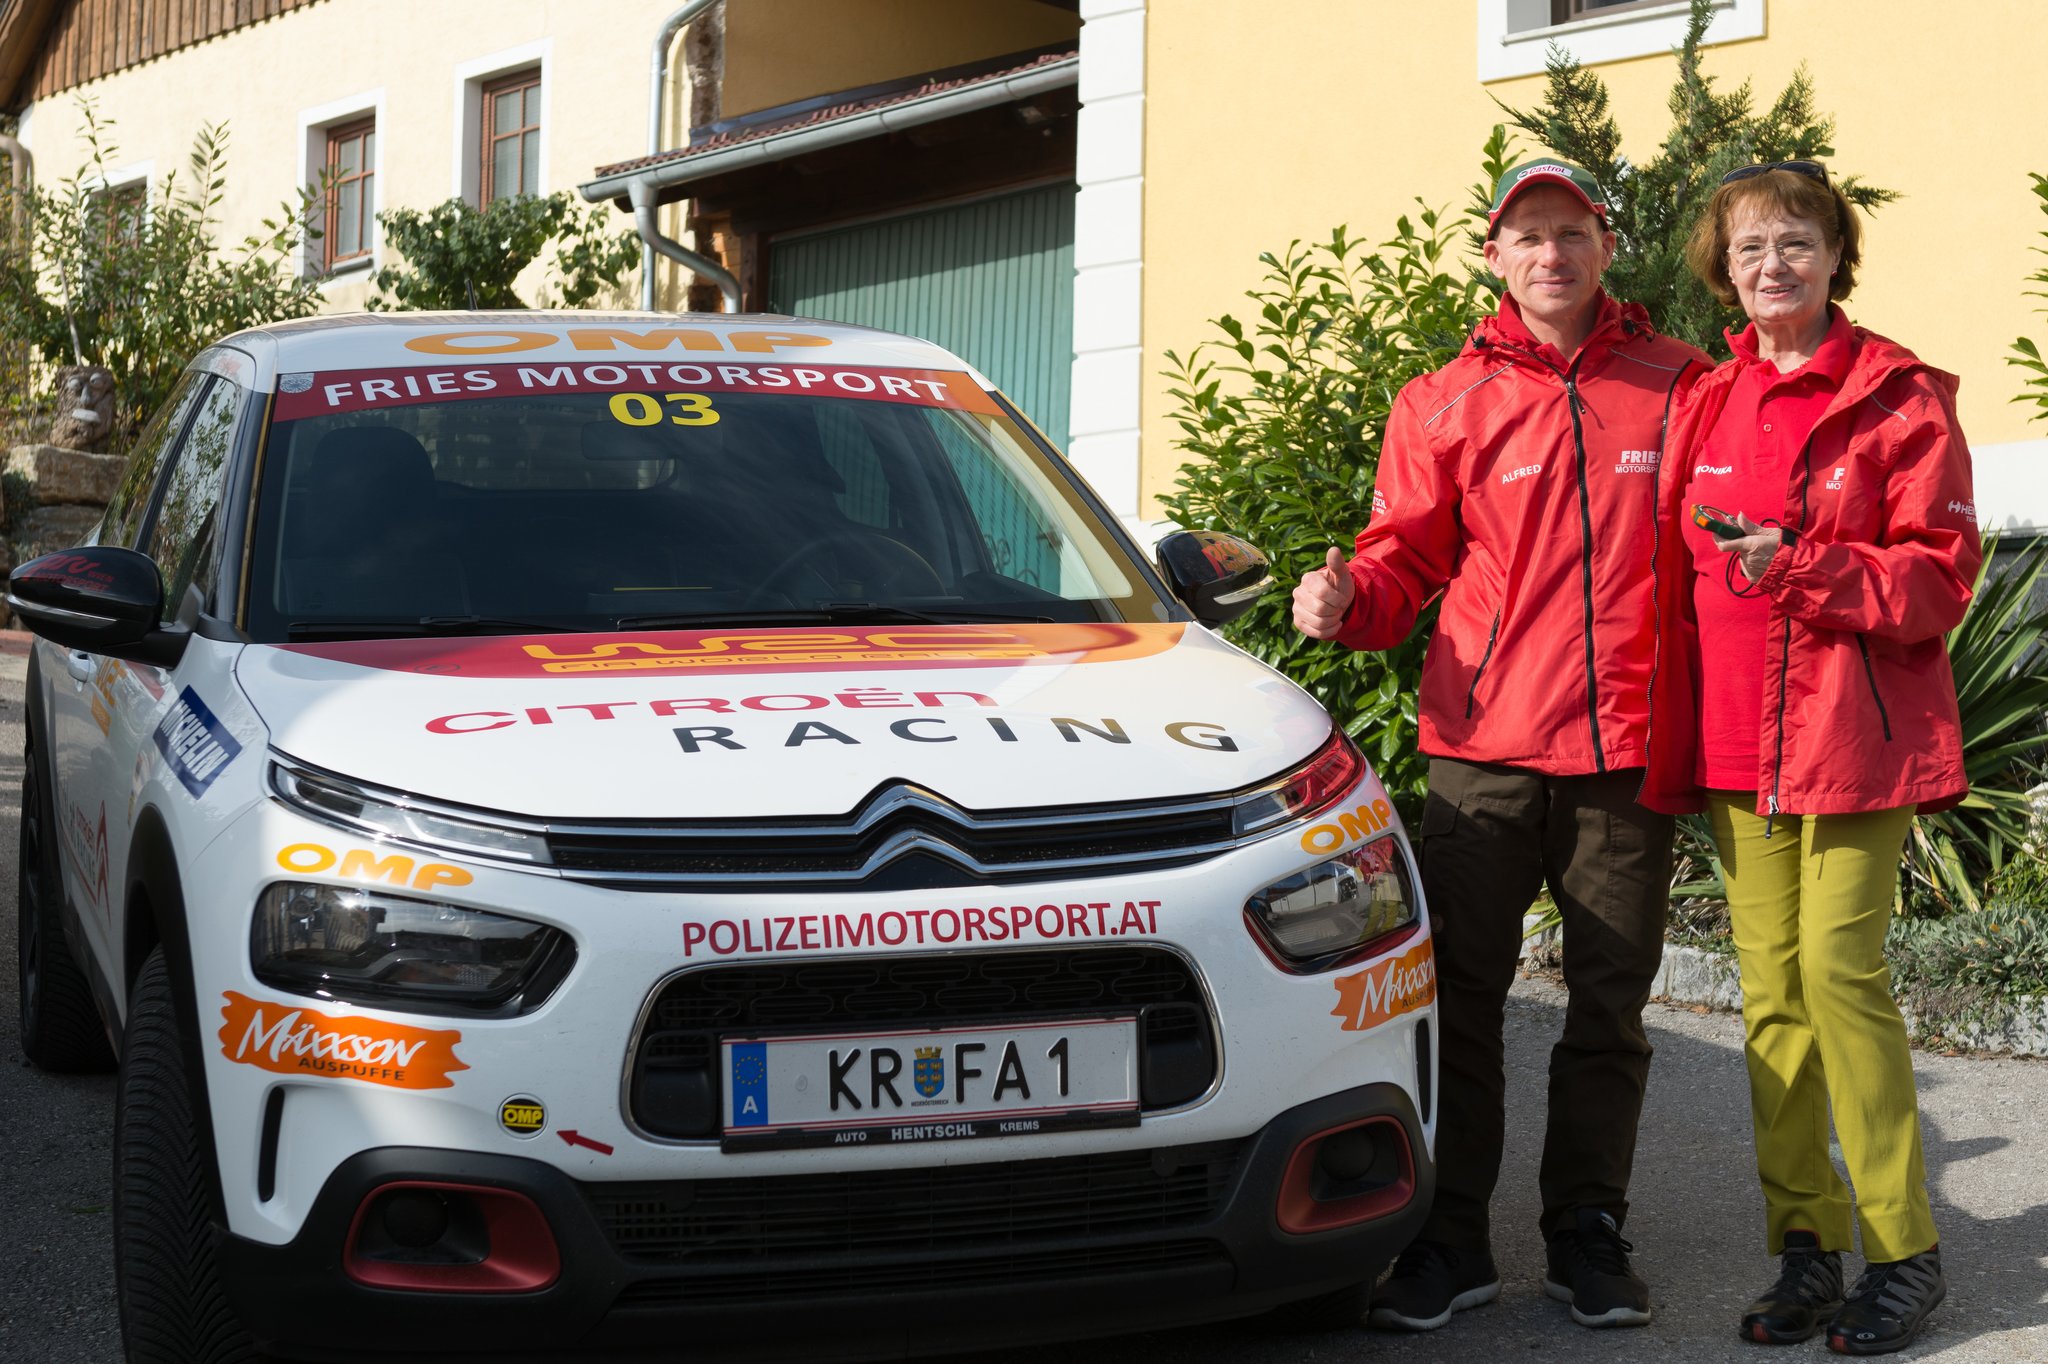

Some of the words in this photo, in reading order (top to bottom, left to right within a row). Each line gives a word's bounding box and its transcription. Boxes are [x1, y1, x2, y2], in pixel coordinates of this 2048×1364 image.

[1529, 165, 1565, 175] Castrol
[403, 328, 834, 356] OMP
[323, 370, 491, 407] FRIES
[519, 364, 947, 401] MOTORSPORT
[608, 392, 720, 427] 03
[1502, 464, 1542, 485] ALFRED
[1615, 465, 1658, 474] MOTORSP
[522, 634, 1035, 659] WRC
[560, 661, 636, 670] FIA
[655, 653, 843, 665] WORLD
[425, 687, 999, 734] CITROËN
[160, 699, 230, 782] MICHELIN
[672, 716, 1239, 753] RACING
[1299, 799, 1391, 855] OMP
[276, 843, 475, 892] OMP
[682, 900, 1162, 957] POLIZEIMOTORSPORT.AT
[299, 1056, 406, 1082] AUSPUFFE
[828, 1047, 902, 1111] KR
[503, 1107, 543, 1125] OMP
[742, 1095, 759, 1115] A
[835, 1131, 868, 1143] AUTO
[891, 1123, 977, 1140] HENTSCHL
[1000, 1119, 1040, 1133] KREMS
